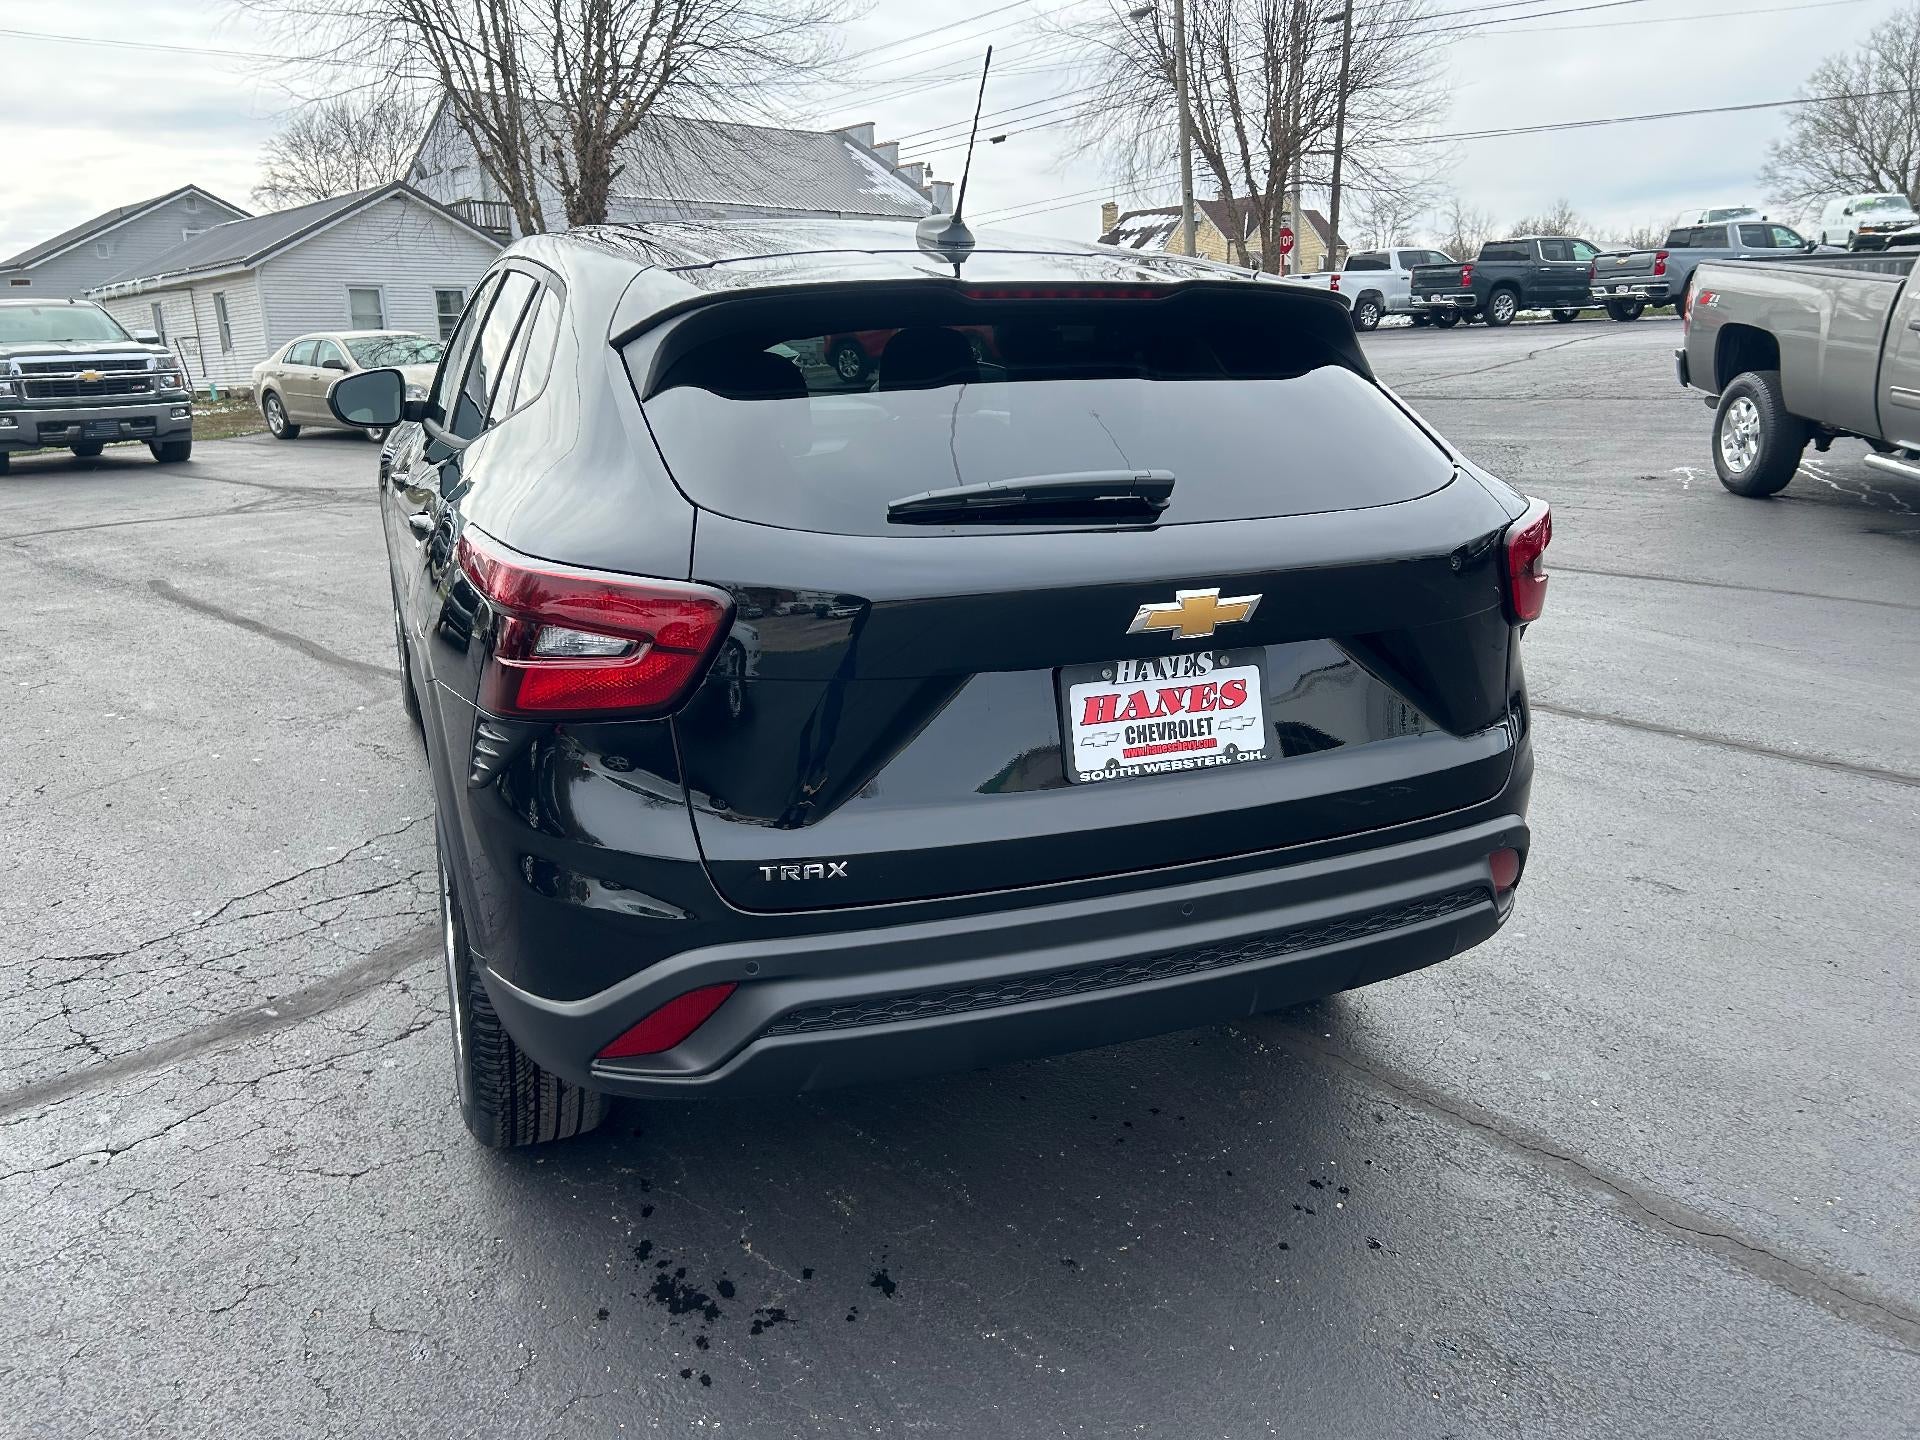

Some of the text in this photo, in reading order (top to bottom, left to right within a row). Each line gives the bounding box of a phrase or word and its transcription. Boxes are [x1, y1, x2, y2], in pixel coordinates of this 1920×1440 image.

[1280, 235, 1293, 247] TOP
[1114, 651, 1214, 684] HANES
[1080, 679, 1247, 726] HANES
[1125, 717, 1214, 745] CHEVROLET
[1123, 738, 1217, 758] www.haneschevy.com
[1079, 750, 1267, 782] SOUTH WEBSTER, OH.
[759, 861, 848, 881] TRAX
